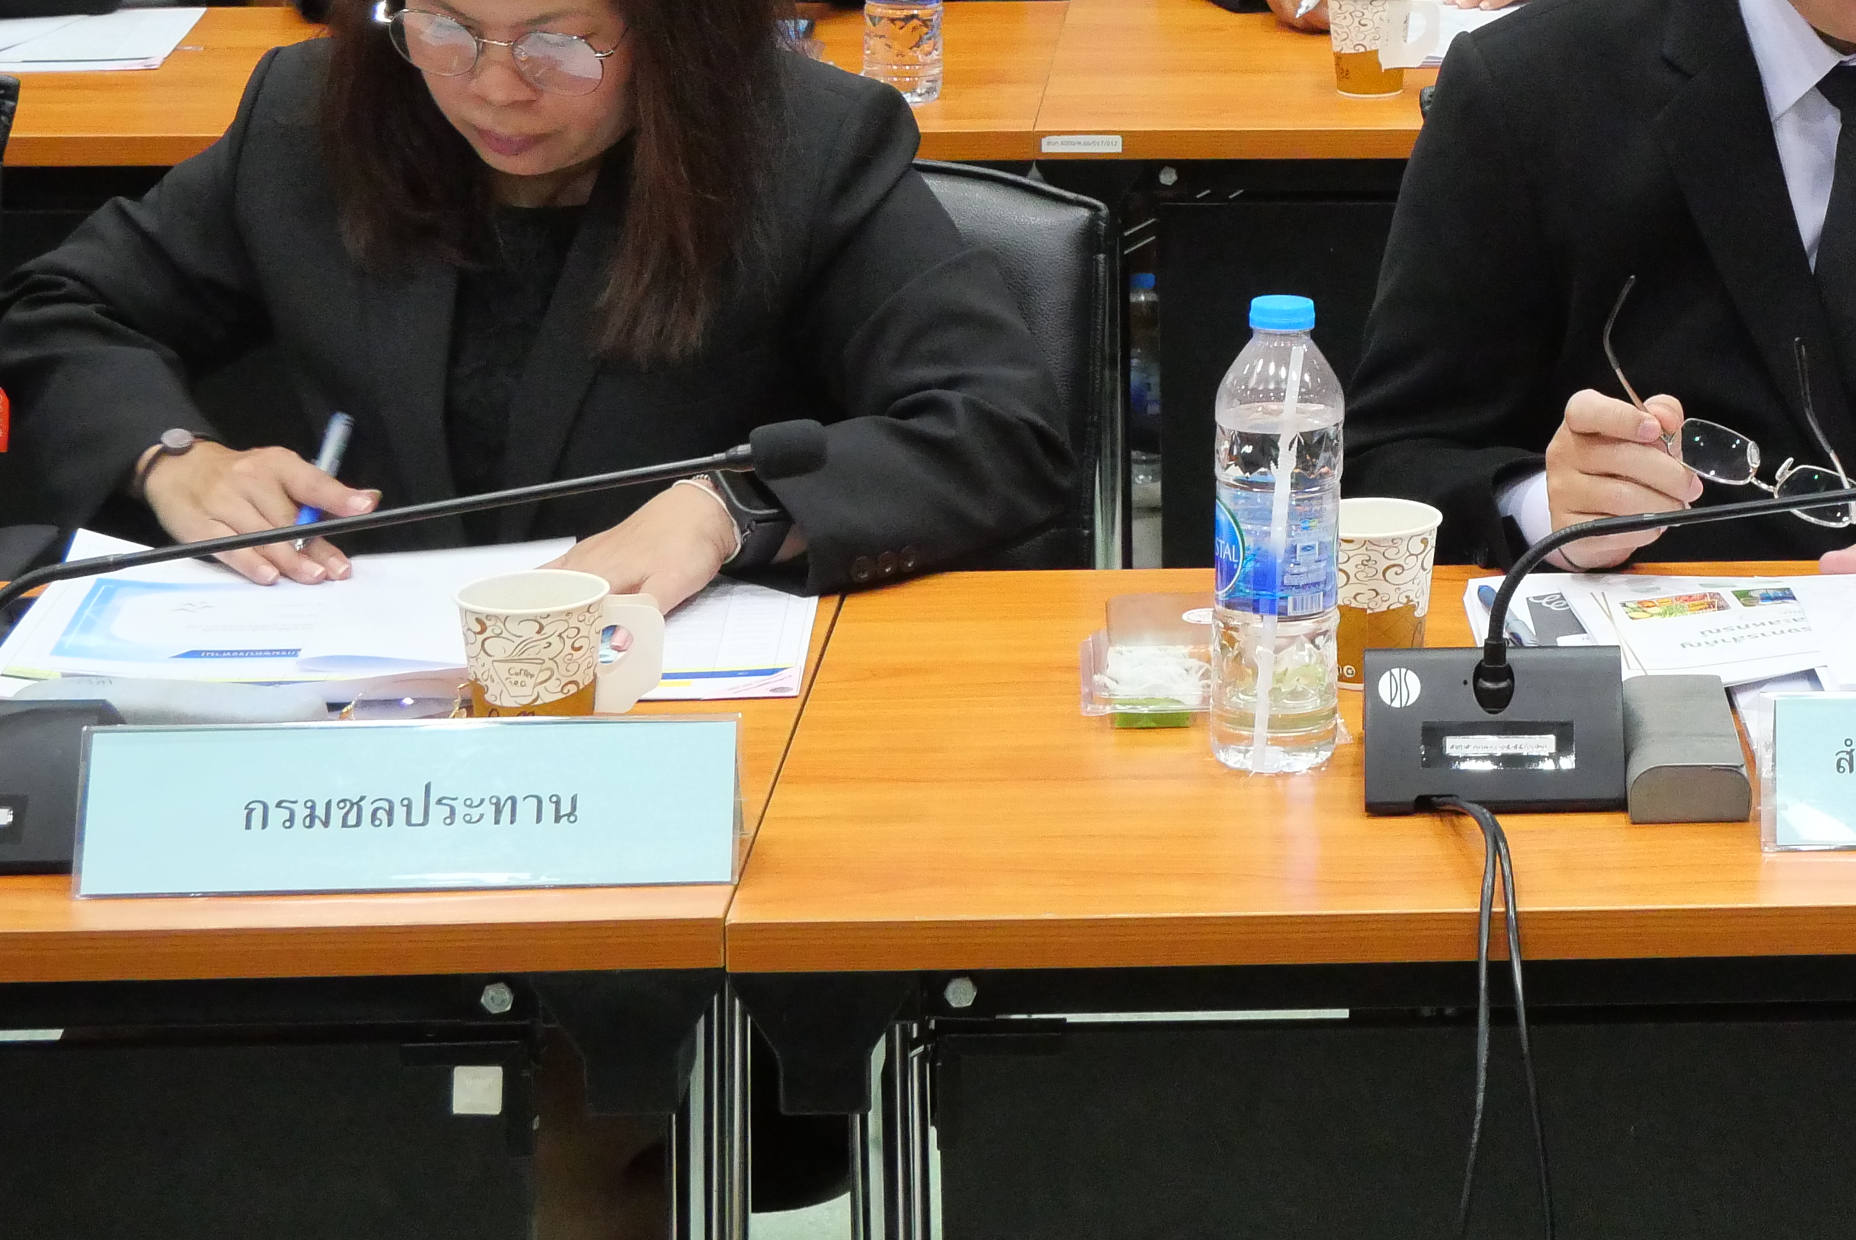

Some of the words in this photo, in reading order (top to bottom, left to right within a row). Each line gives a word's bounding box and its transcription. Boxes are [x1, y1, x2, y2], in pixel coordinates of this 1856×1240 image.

[1215, 537, 1239, 563] STAL
[242, 782, 578, 831] กรมชลประทาน
